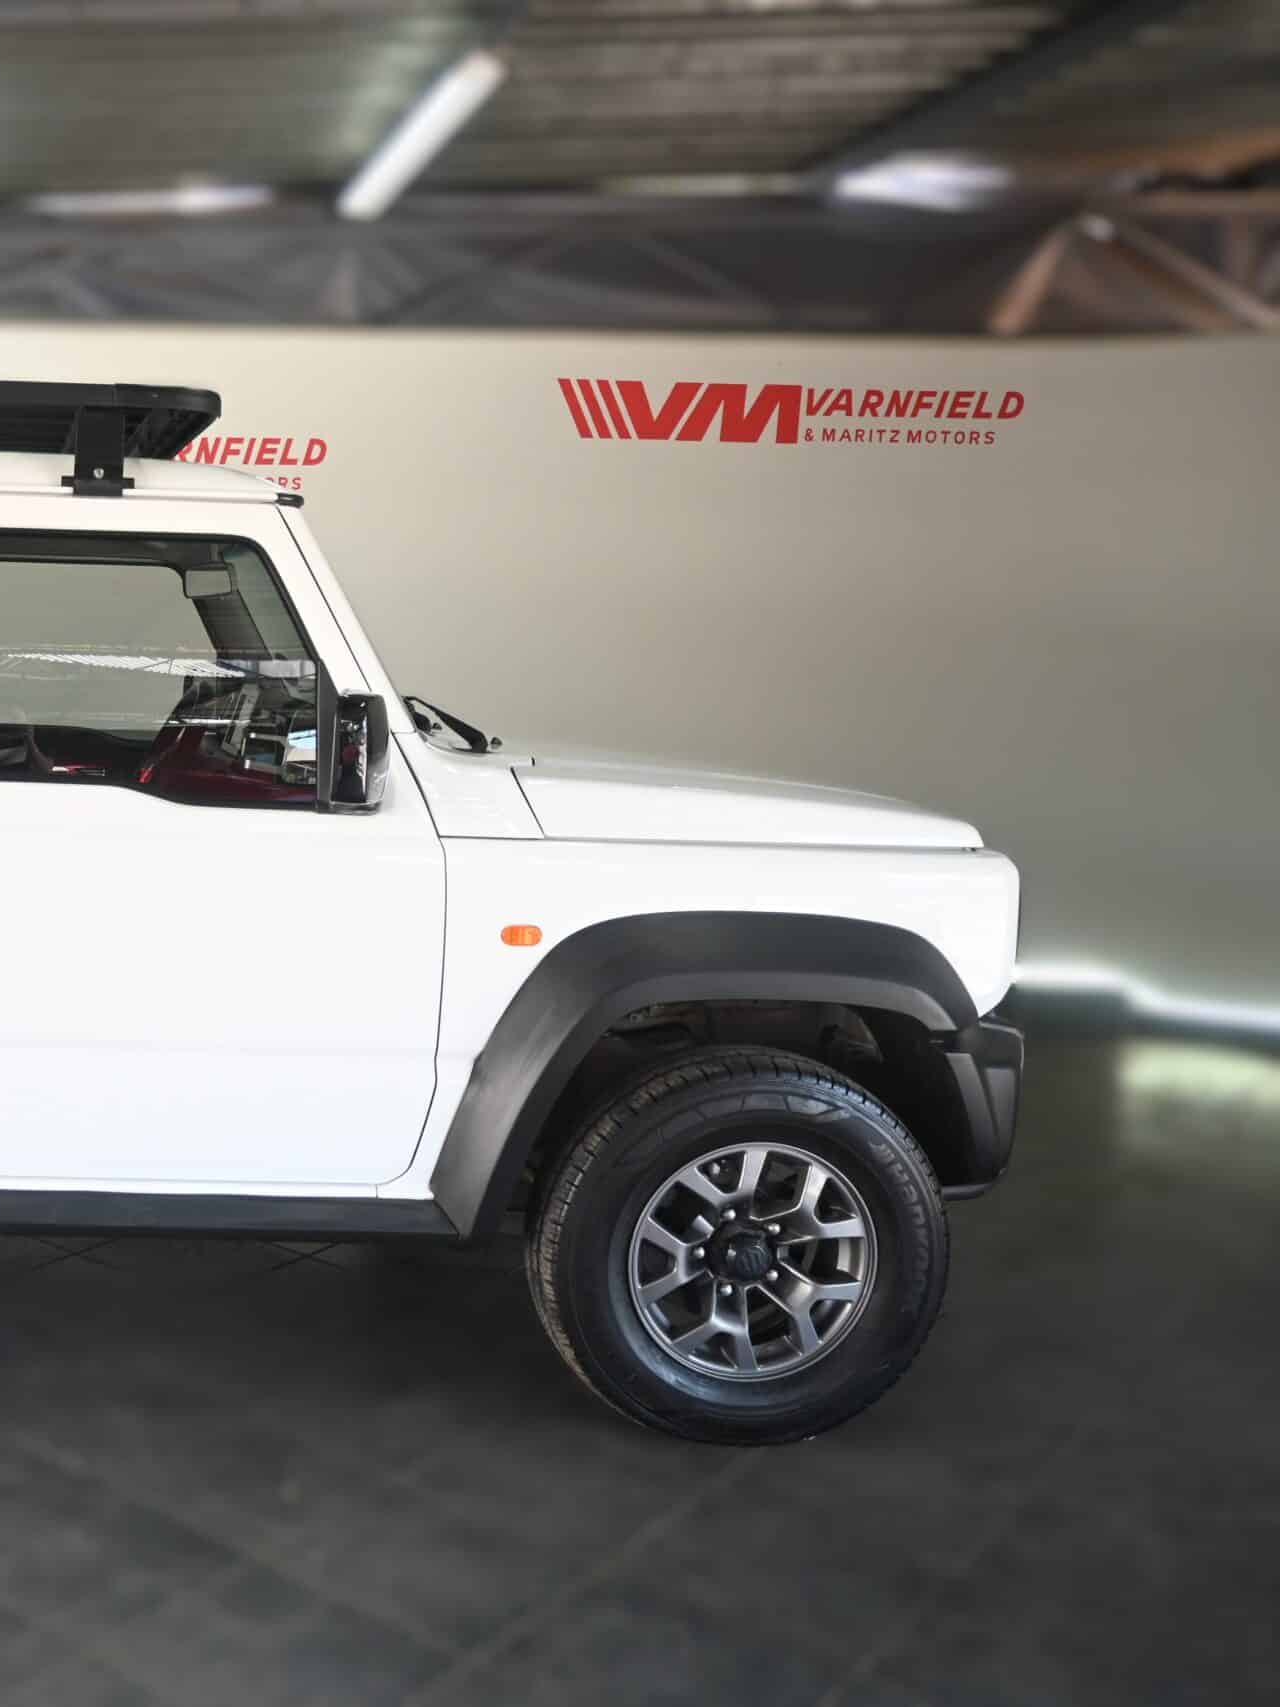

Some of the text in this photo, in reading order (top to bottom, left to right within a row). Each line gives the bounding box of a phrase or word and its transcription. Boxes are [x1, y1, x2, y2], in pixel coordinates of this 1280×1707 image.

[615, 380, 803, 444] VM
[805, 387, 1025, 419] VARNFIELD
[177, 437, 328, 465] NFIELD
[805, 428, 996, 444] & MARITZ MOTORS
